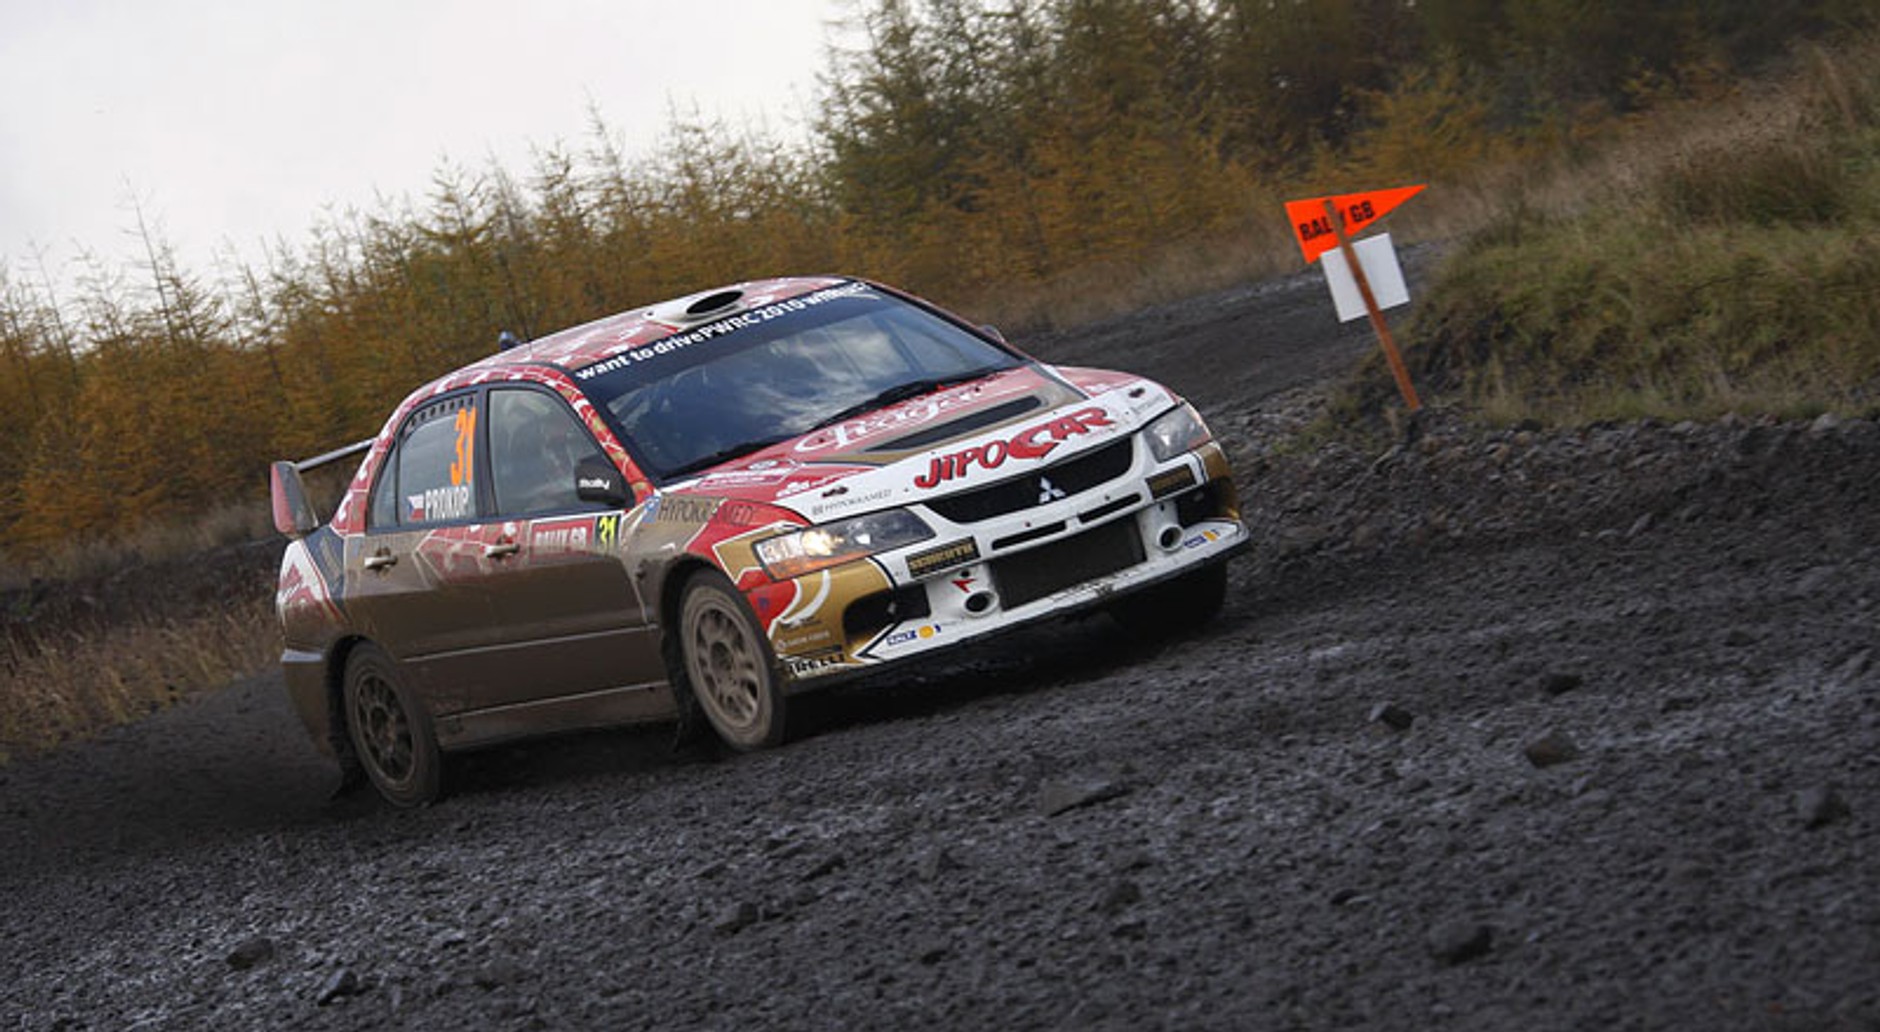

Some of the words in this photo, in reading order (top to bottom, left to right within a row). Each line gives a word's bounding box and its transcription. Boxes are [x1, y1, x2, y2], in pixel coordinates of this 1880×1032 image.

[1299, 209, 1347, 241] RAL
[1350, 201, 1375, 222] GB
[575, 354, 631, 379] want
[629, 347, 654, 361] to
[654, 332, 703, 353] drive
[698, 309, 760, 338] PWRC
[758, 299, 807, 320] 2010
[451, 406, 477, 486] 31
[914, 407, 1115, 488] JIPOCAR
[425, 486, 469, 521] PROKOP
[657, 499, 753, 524] HYPOKED
[570, 525, 588, 552] GB
